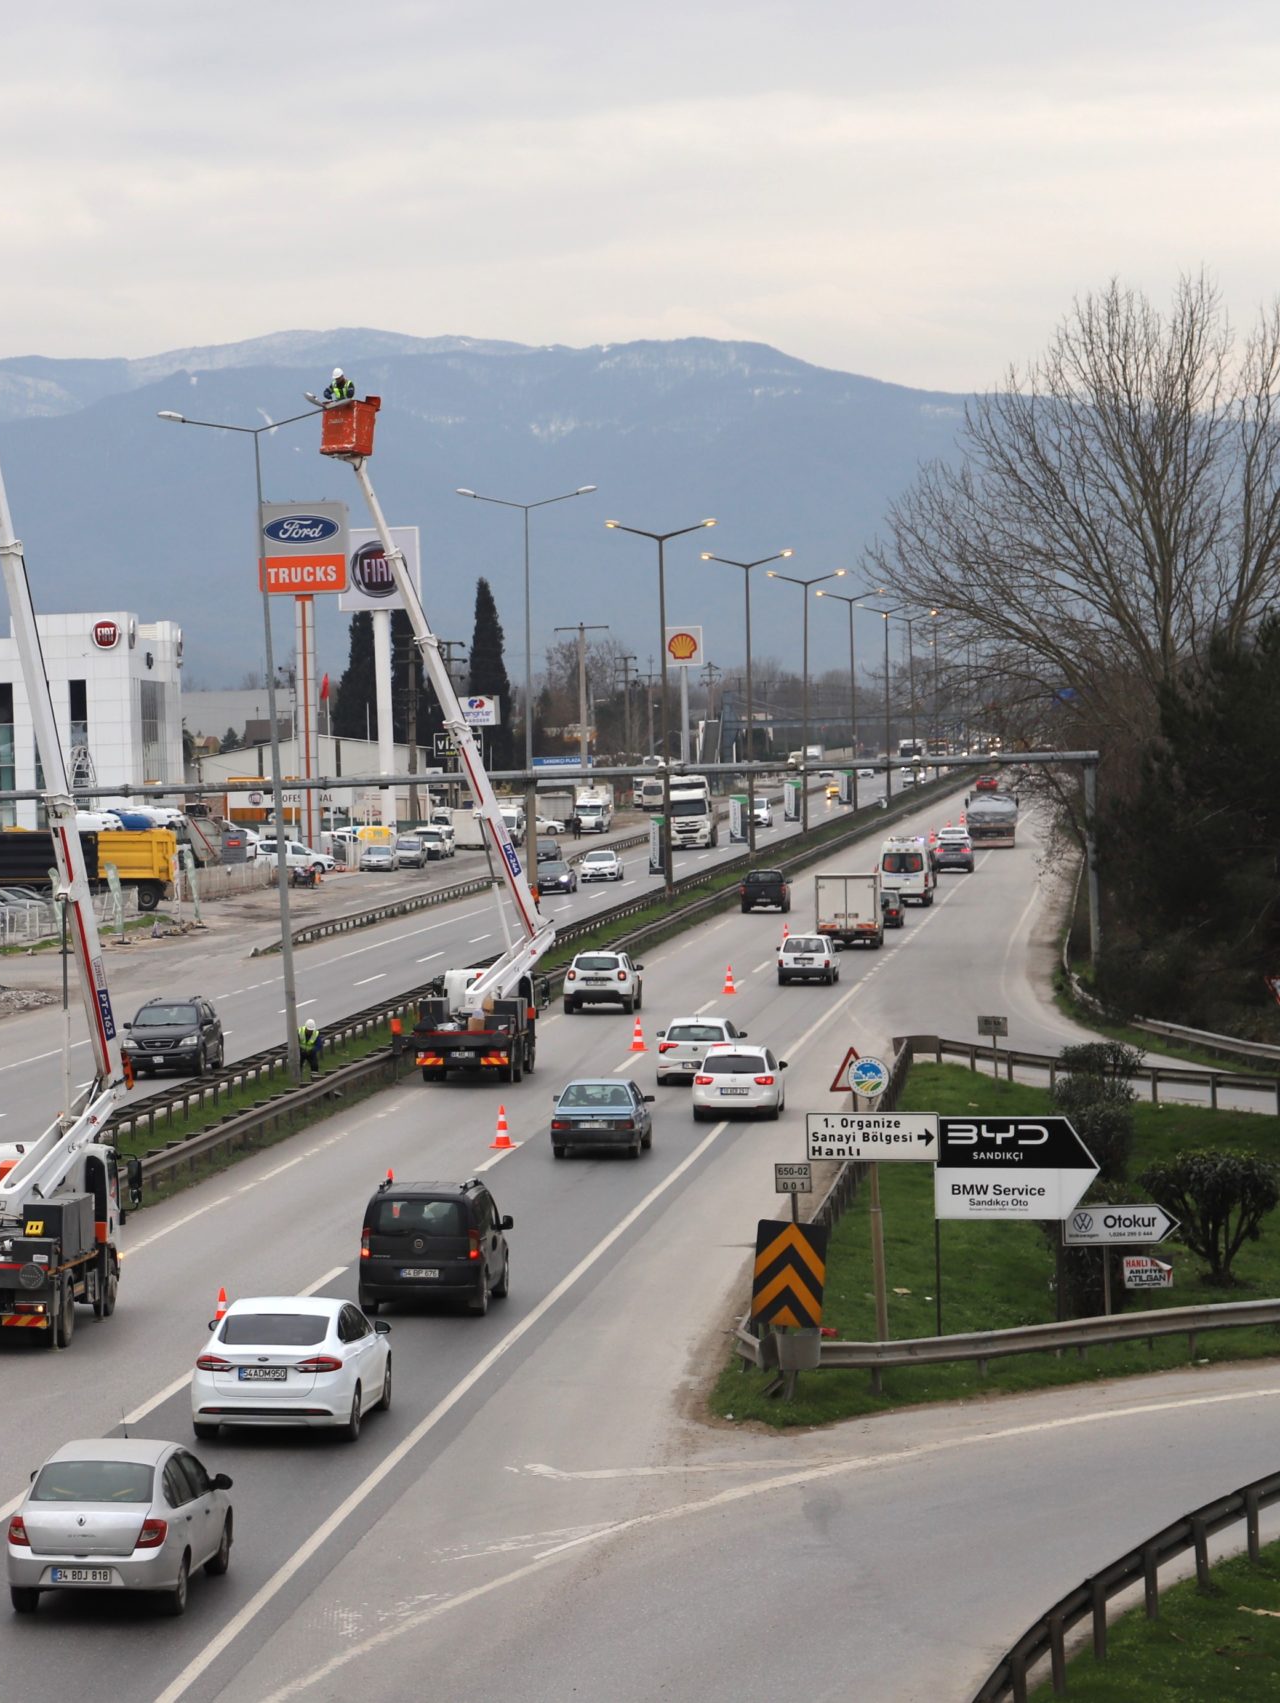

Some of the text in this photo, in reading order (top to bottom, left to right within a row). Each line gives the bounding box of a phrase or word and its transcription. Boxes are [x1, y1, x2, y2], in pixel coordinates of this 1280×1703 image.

[279, 520, 323, 538] Ford
[268, 565, 337, 584] TRUCKS
[99, 993, 114, 1035] PT-163
[823, 1118, 901, 1131] 1. Organize
[812, 1131, 913, 1144] Sanayi Bölgesi
[947, 1124, 1049, 1145] BYD
[812, 1146, 861, 1156] Hanlı
[972, 1151, 1023, 1161] SANDIKÇI
[778, 1167, 808, 1176] 650-02
[951, 1184, 1046, 1196] BMW Service
[969, 1198, 1029, 1208] Sandıkçı Oto
[1103, 1214, 1157, 1229] Otokur
[57, 1570, 108, 1581] 34 BDJ 818
